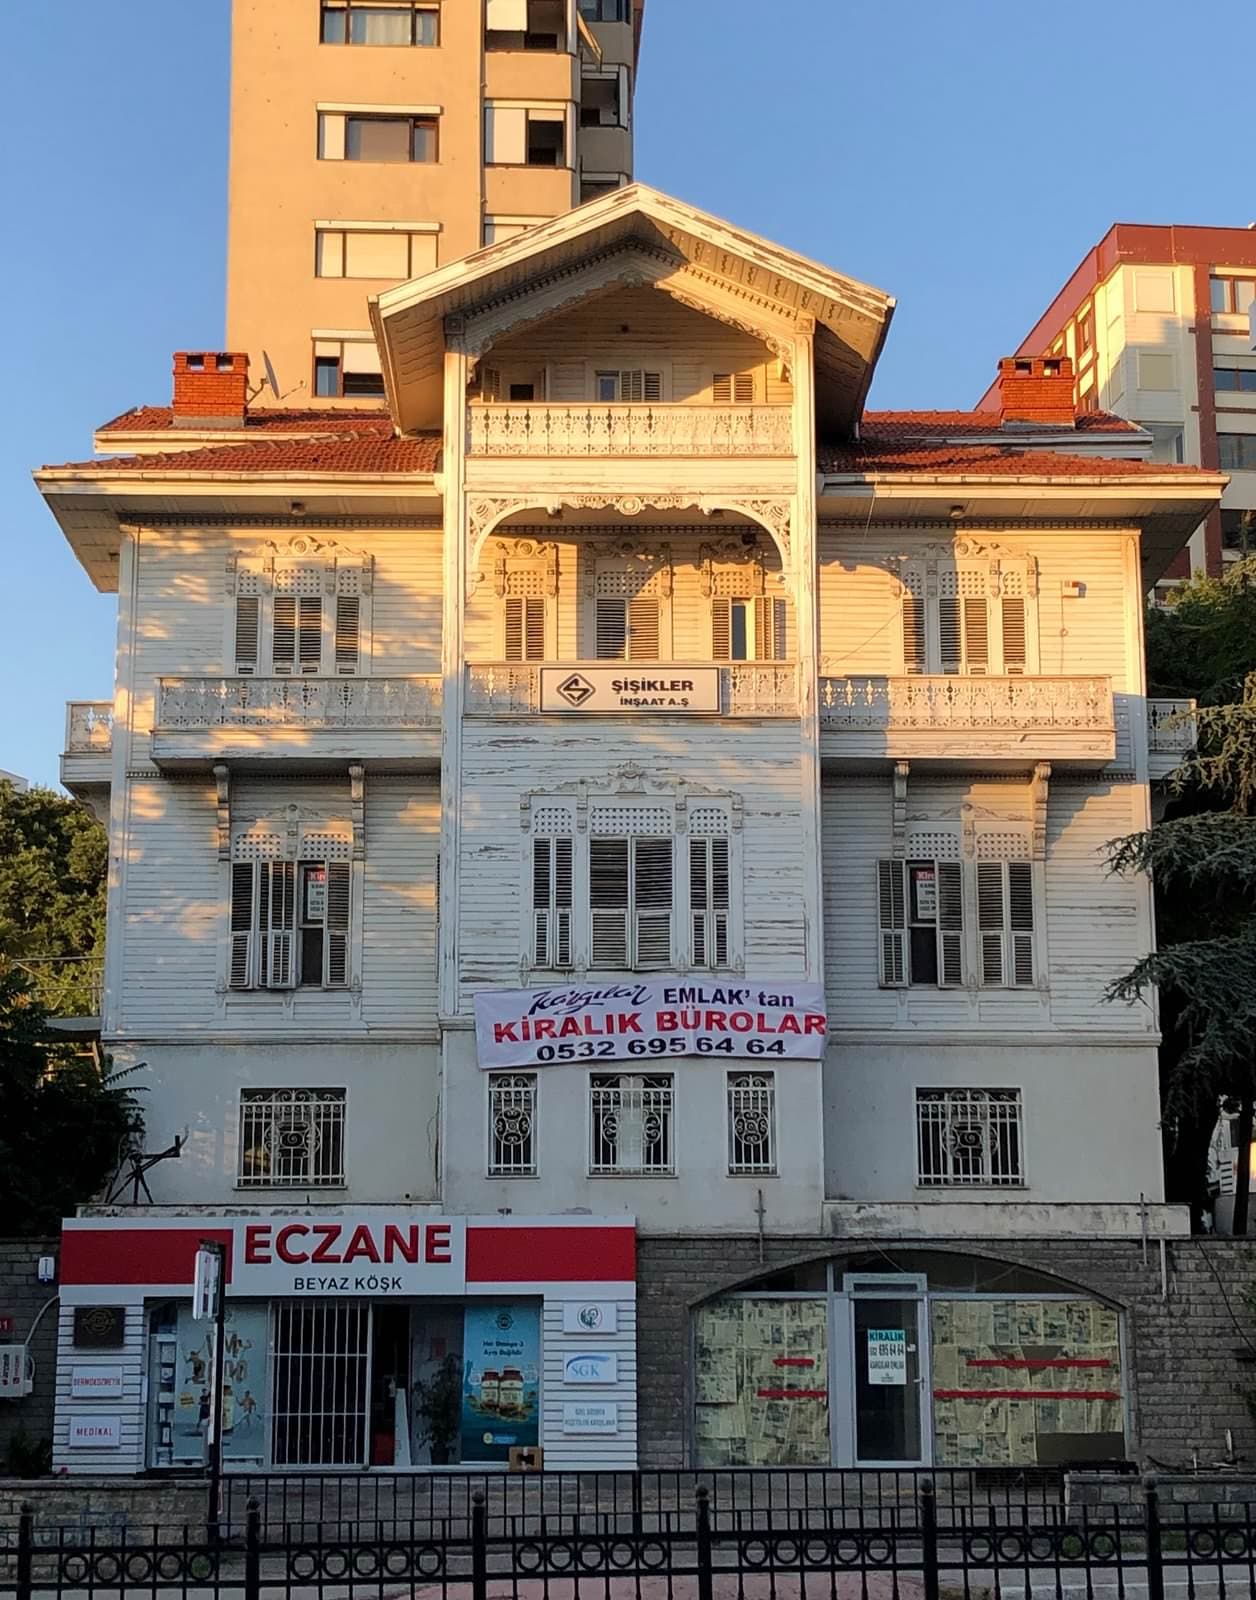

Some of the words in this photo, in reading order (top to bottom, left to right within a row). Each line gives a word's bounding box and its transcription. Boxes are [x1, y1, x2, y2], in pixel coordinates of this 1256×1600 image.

[611, 677, 694, 695] ŞİŞİKLER
[620, 697, 665, 707] İNŞAAT
[758, 990, 795, 1008] tan
[493, 1011, 643, 1044] KİRALIK
[655, 1006, 826, 1036] BÜROLAR
[536, 1041, 615, 1062] 0532
[627, 1037, 687, 1056] 695
[696, 1037, 735, 1054] 64
[746, 1038, 786, 1056] 64
[244, 1222, 453, 1265] ECZANE
[293, 1276, 350, 1291] BEYAZ
[354, 1273, 403, 1294] KÖŞK
[869, 1331, 904, 1341] KİRALIK
[571, 1363, 600, 1377] SGK
[76, 1426, 112, 1437] MEDİKAL
